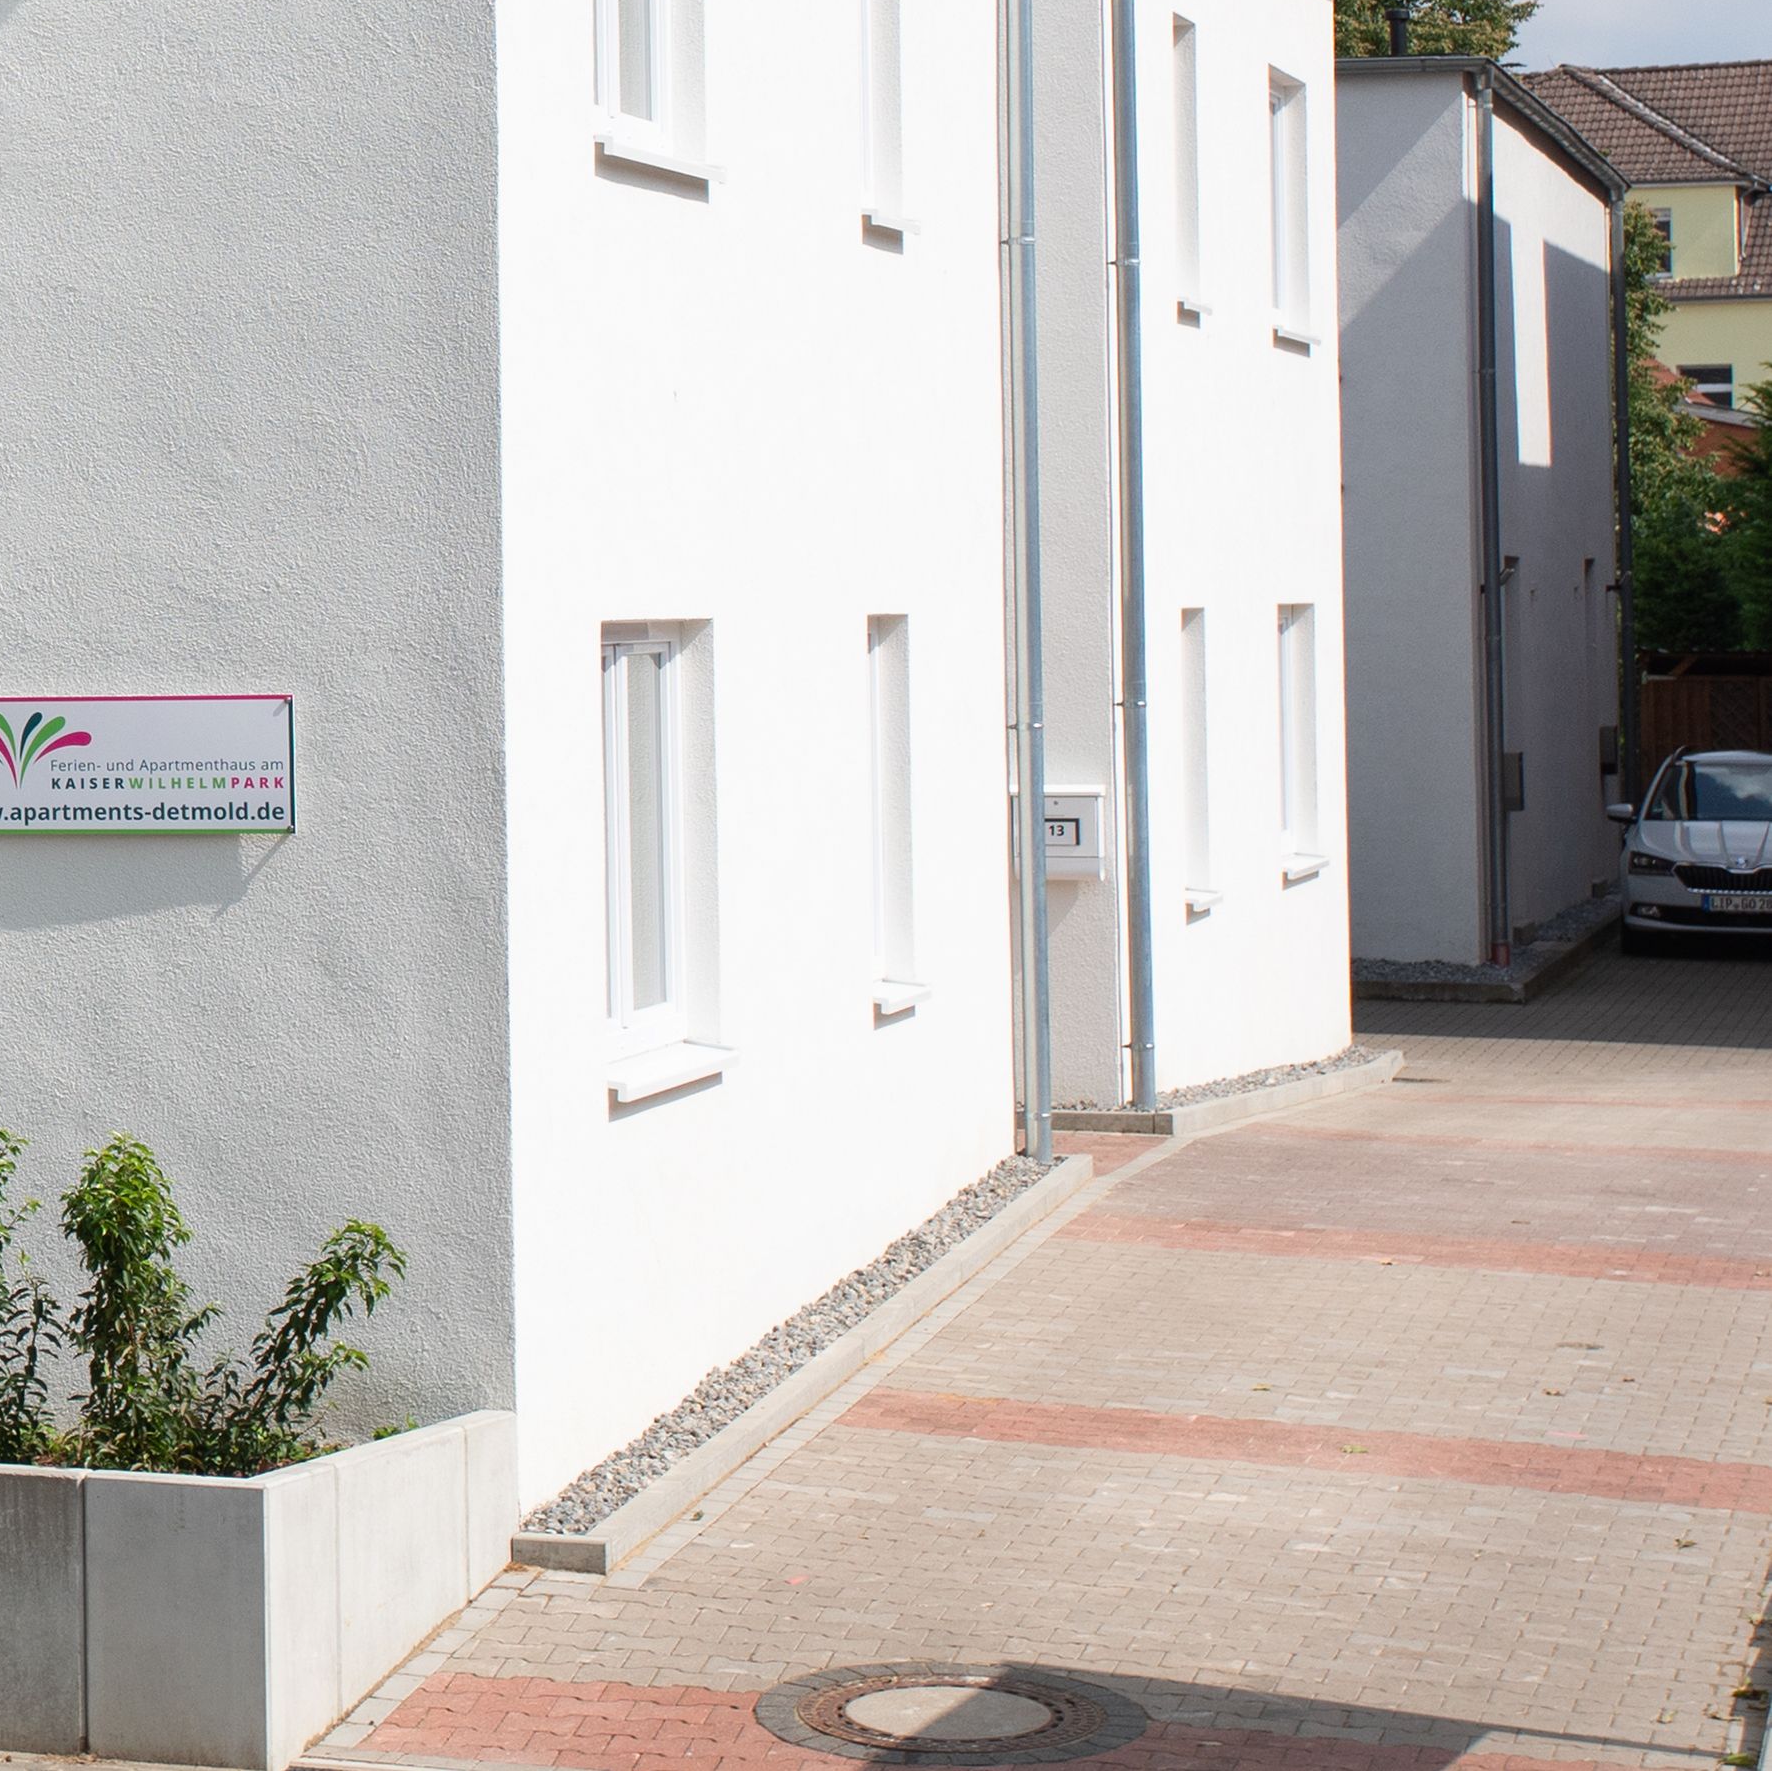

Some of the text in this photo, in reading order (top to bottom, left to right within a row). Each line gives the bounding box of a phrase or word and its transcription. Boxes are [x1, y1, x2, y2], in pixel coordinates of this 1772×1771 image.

[50, 758, 284, 774] Ferien- und Apartmenthaus am
[1049, 825, 1065, 836] 13
